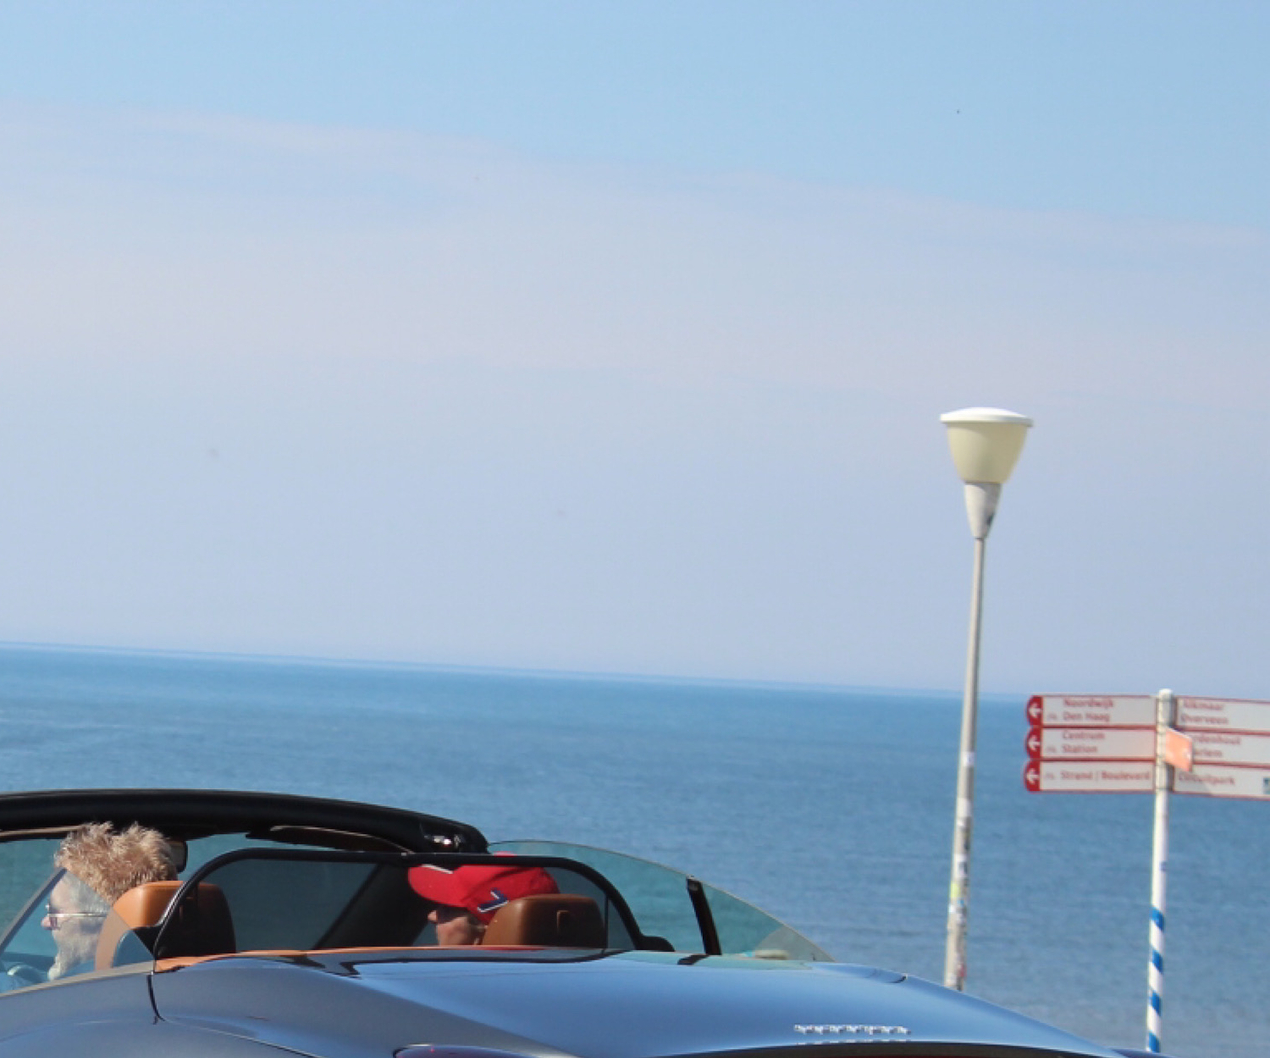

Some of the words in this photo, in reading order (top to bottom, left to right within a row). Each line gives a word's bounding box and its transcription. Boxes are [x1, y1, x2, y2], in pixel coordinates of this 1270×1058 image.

[1063, 698, 1113, 709] Noordwijk
[1183, 699, 1225, 711] Alkmaar
[1063, 711, 1082, 721] Den
[1086, 711, 1110, 722] Haag
[1181, 713, 1229, 725] Overveen
[1063, 730, 1105, 740] Centrum
[1062, 744, 1098, 753] Station
[1060, 770, 1093, 780] Strand
